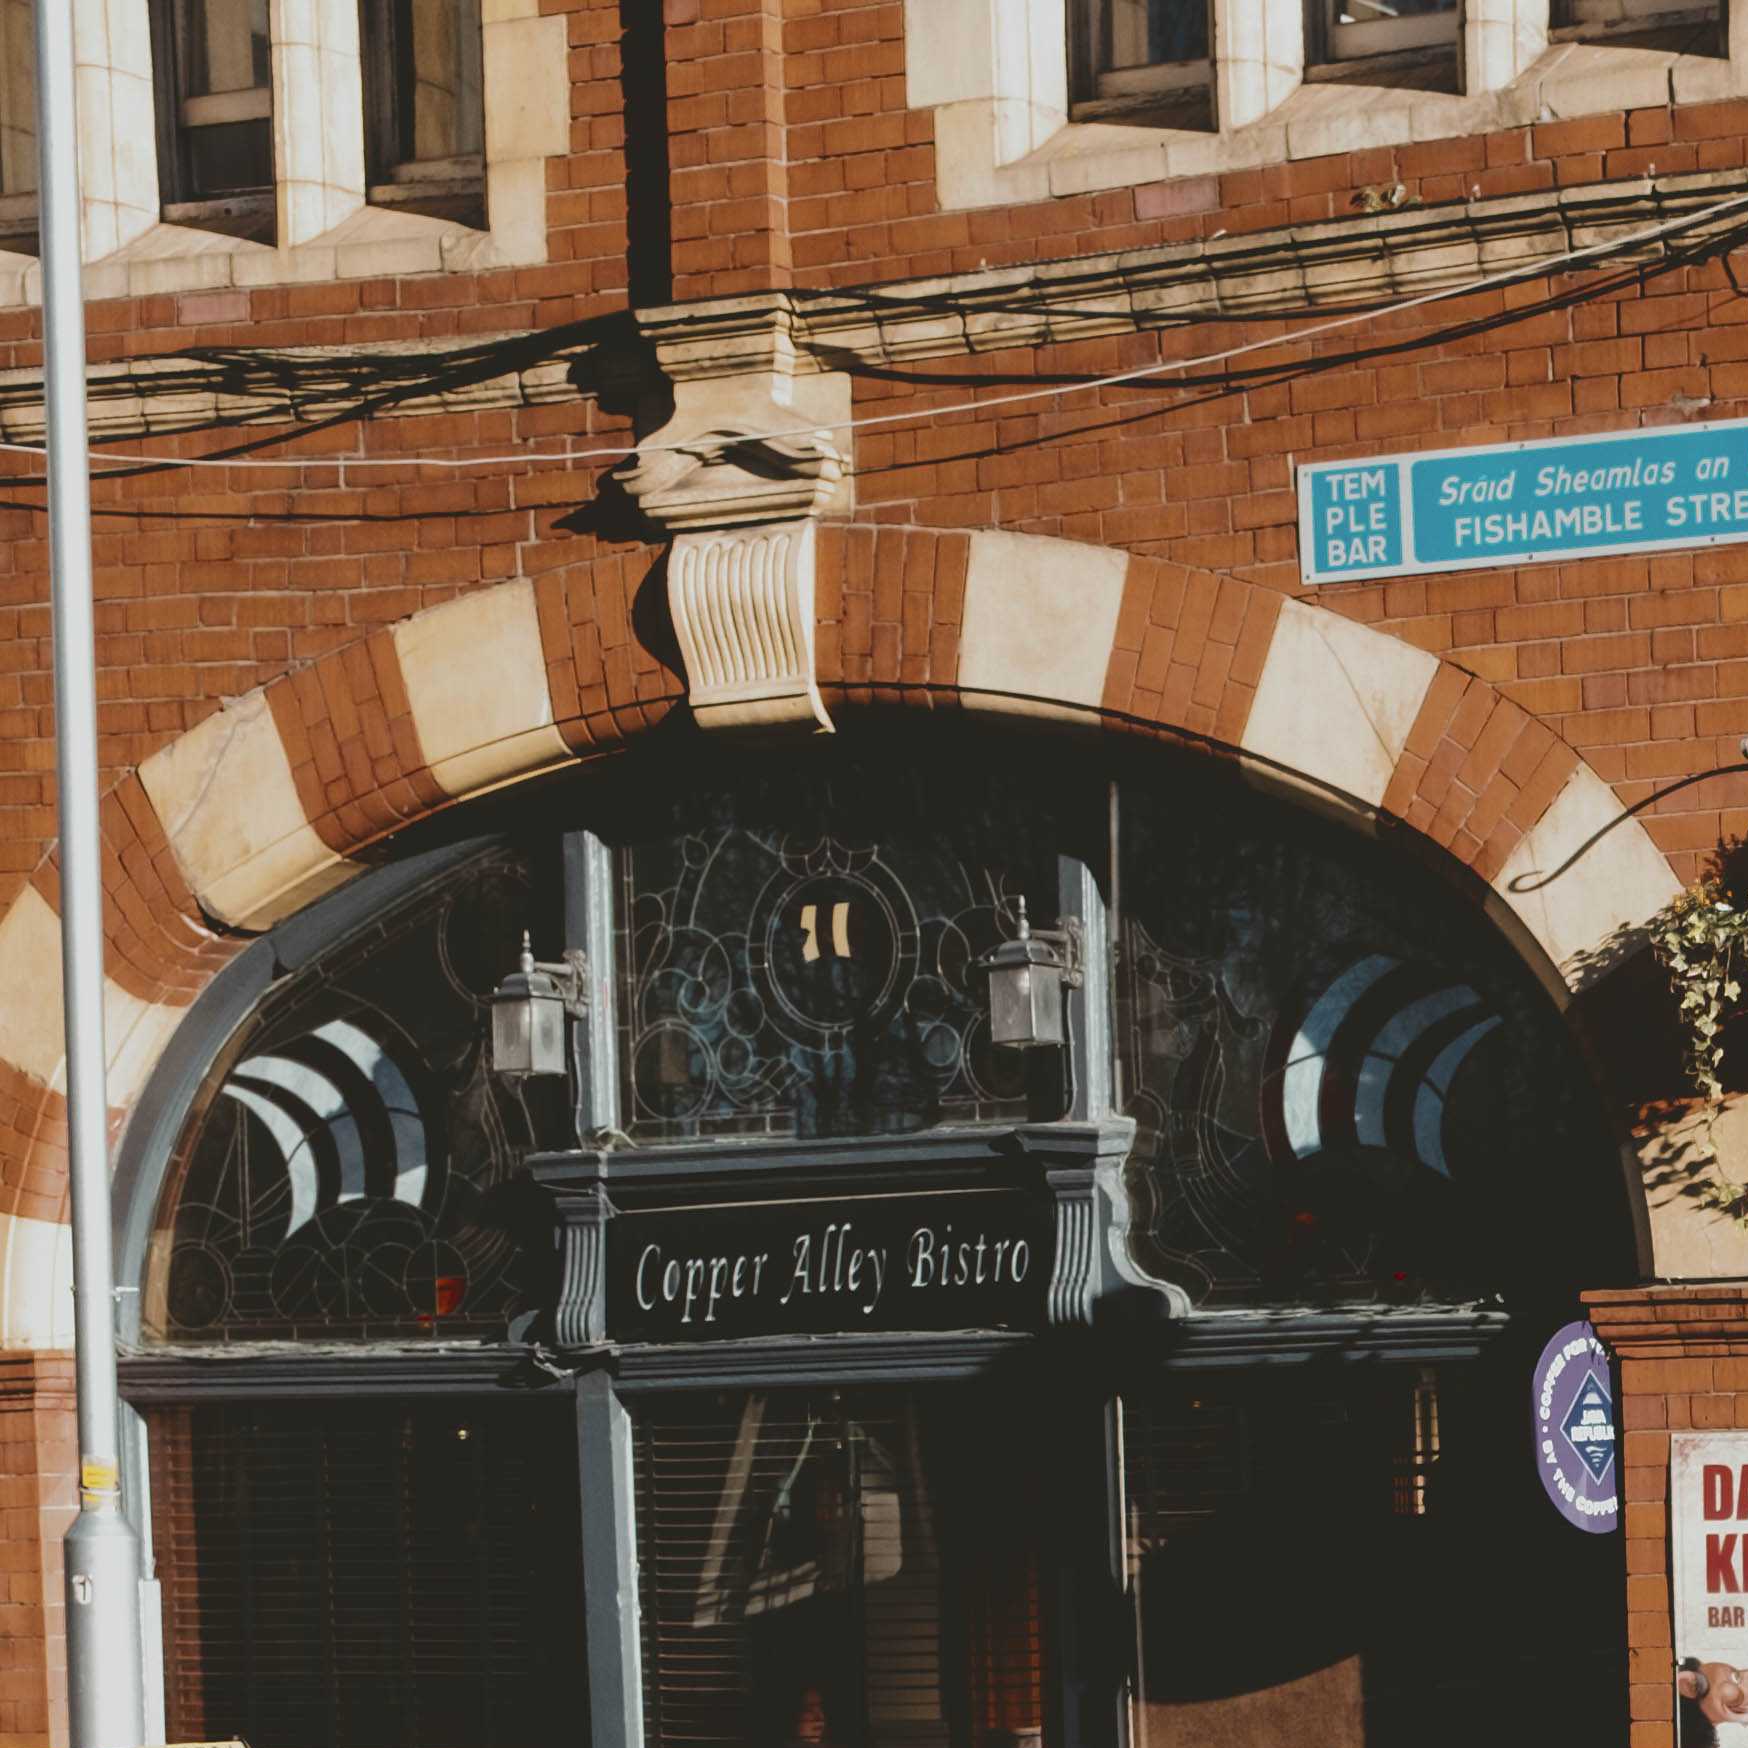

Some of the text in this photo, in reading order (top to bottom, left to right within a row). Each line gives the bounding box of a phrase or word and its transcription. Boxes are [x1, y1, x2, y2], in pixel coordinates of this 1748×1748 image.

[1325, 469, 1386, 502] TEM
[1535, 460, 1676, 498] Sheamlas
[1696, 455, 1729, 479] an
[1326, 502, 1388, 535] PLE
[1454, 503, 1643, 547] FISHAMBLE
[1326, 534, 1388, 567] BAR
[635, 1223, 1031, 1323] Copper Alley Bistro
[1707, 1605, 1745, 1628] BAR
